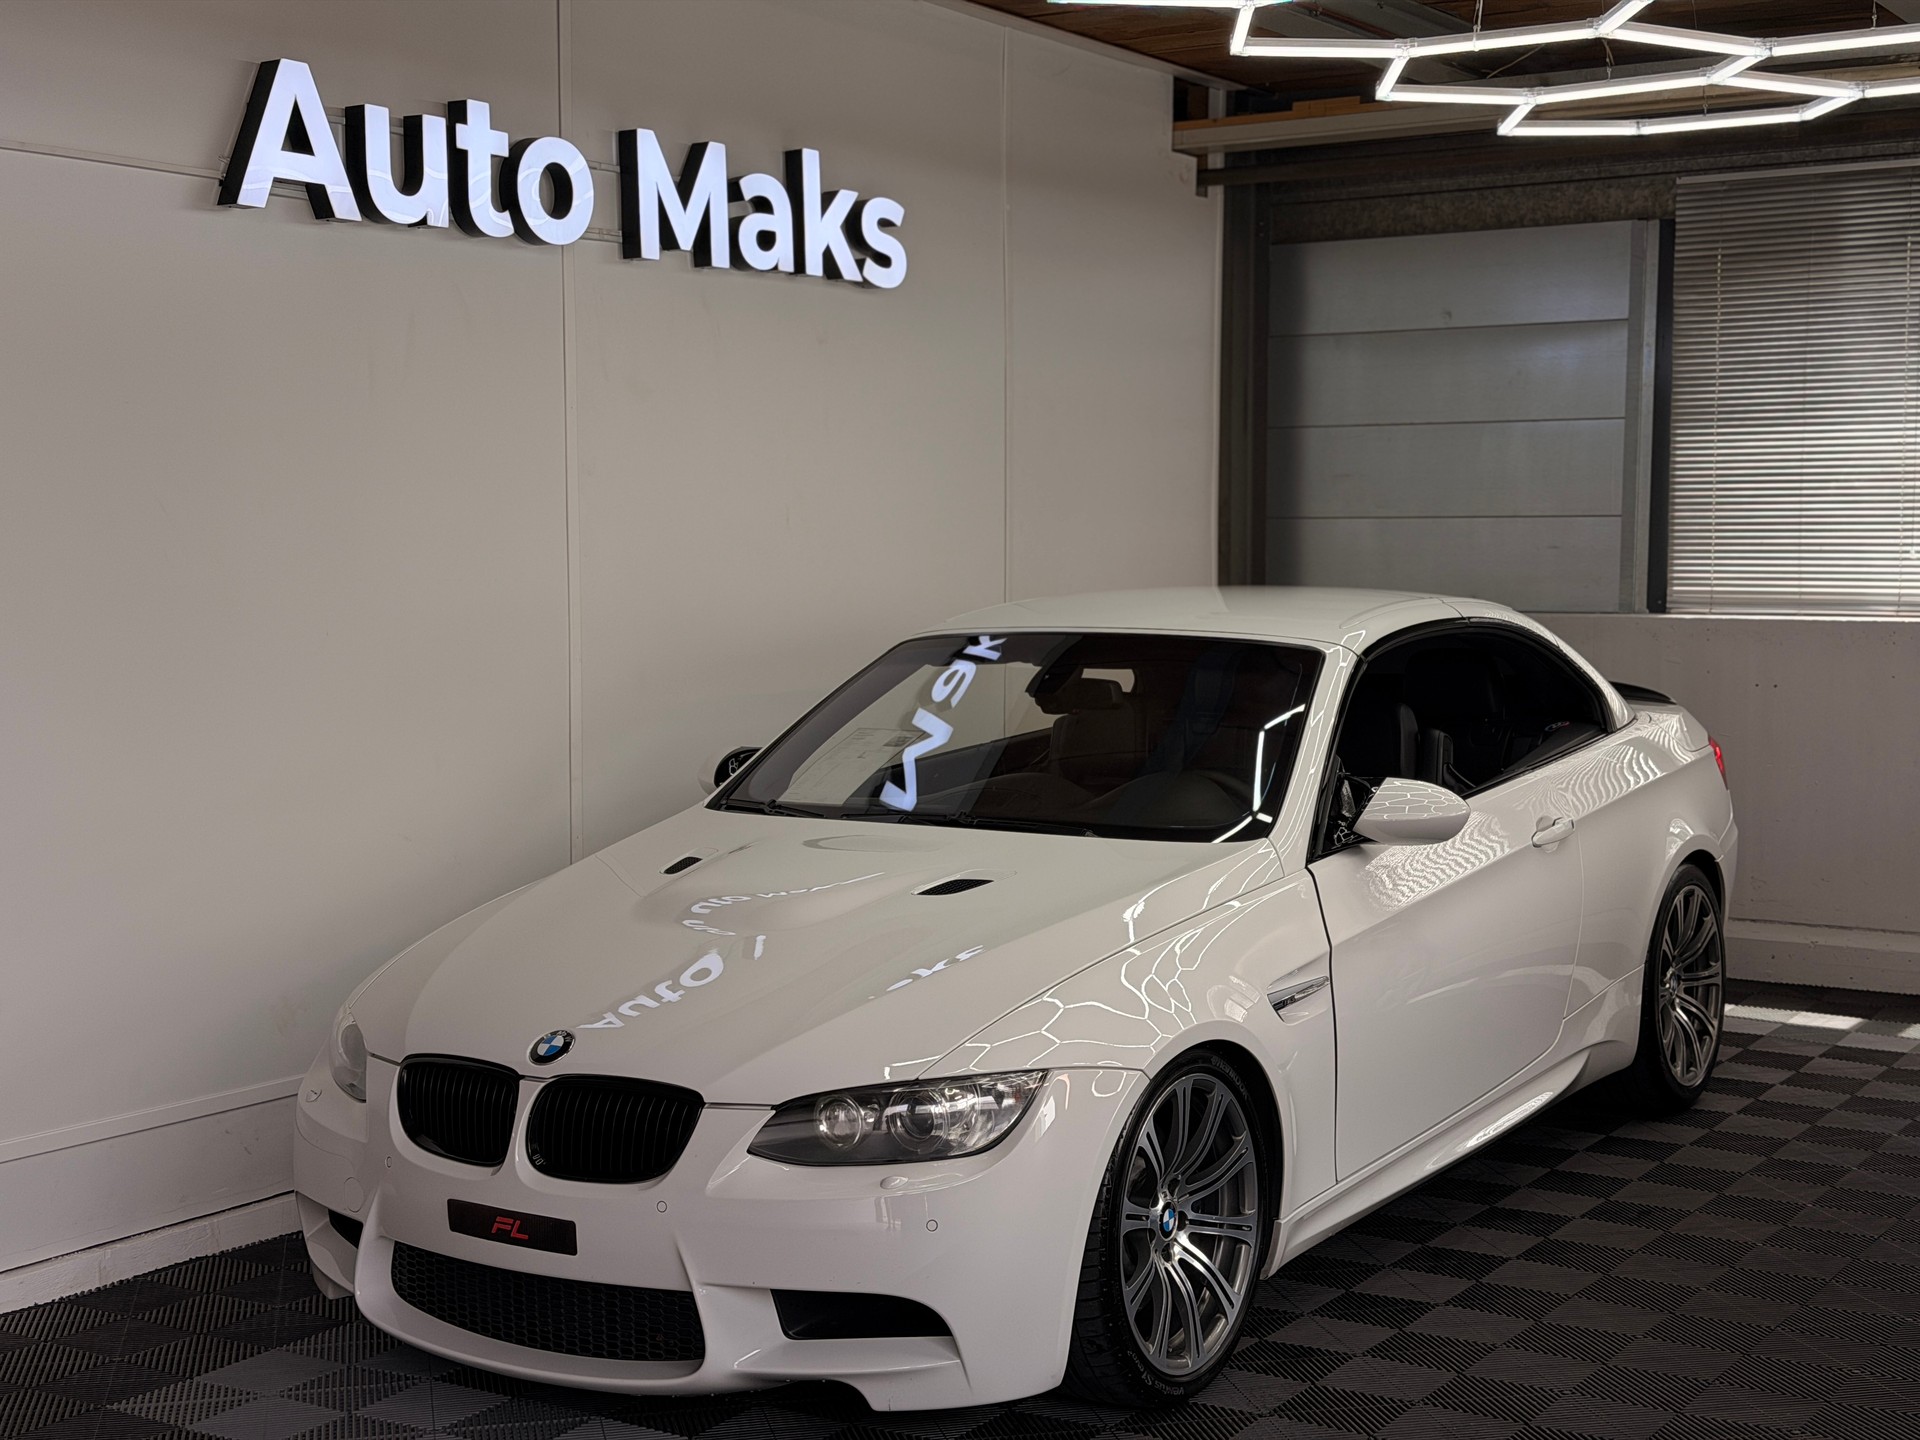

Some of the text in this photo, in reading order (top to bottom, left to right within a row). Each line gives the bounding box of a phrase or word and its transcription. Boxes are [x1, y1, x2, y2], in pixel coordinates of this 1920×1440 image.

[220, 57, 908, 289] Auto Maks
[491, 1216, 529, 1240] FL
